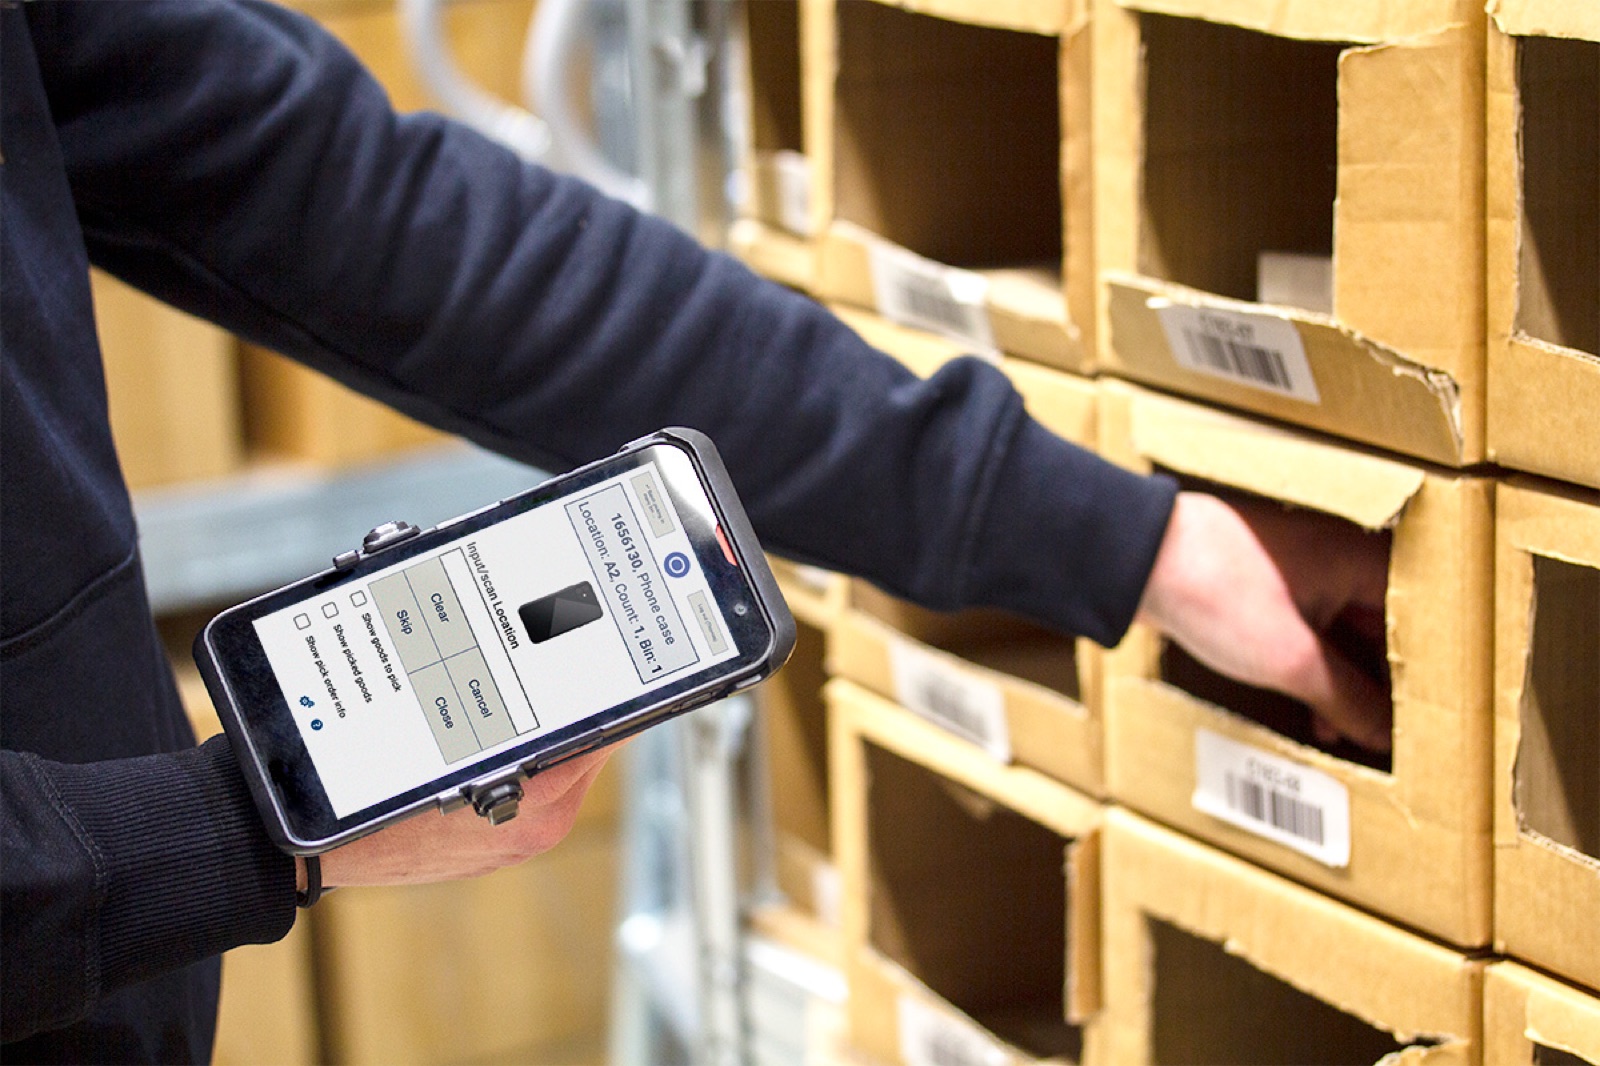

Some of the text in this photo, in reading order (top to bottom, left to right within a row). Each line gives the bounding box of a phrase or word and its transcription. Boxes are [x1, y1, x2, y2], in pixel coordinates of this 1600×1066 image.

[430, 592, 450, 622] Clear
[466, 541, 519, 649] Input/scan Location
[578, 500, 663, 673] Location: A2, Count: 1, Bin: 1
[611, 512, 675, 645] 1656130, Phone case
[361, 612, 401, 692] Show goods to pick
[396, 609, 413, 635] Skip
[305, 635, 346, 718] Show pick order info
[332, 623, 372, 703] Show picked goods
[468, 678, 493, 718] Cancel
[434, 696, 454, 729] Close
